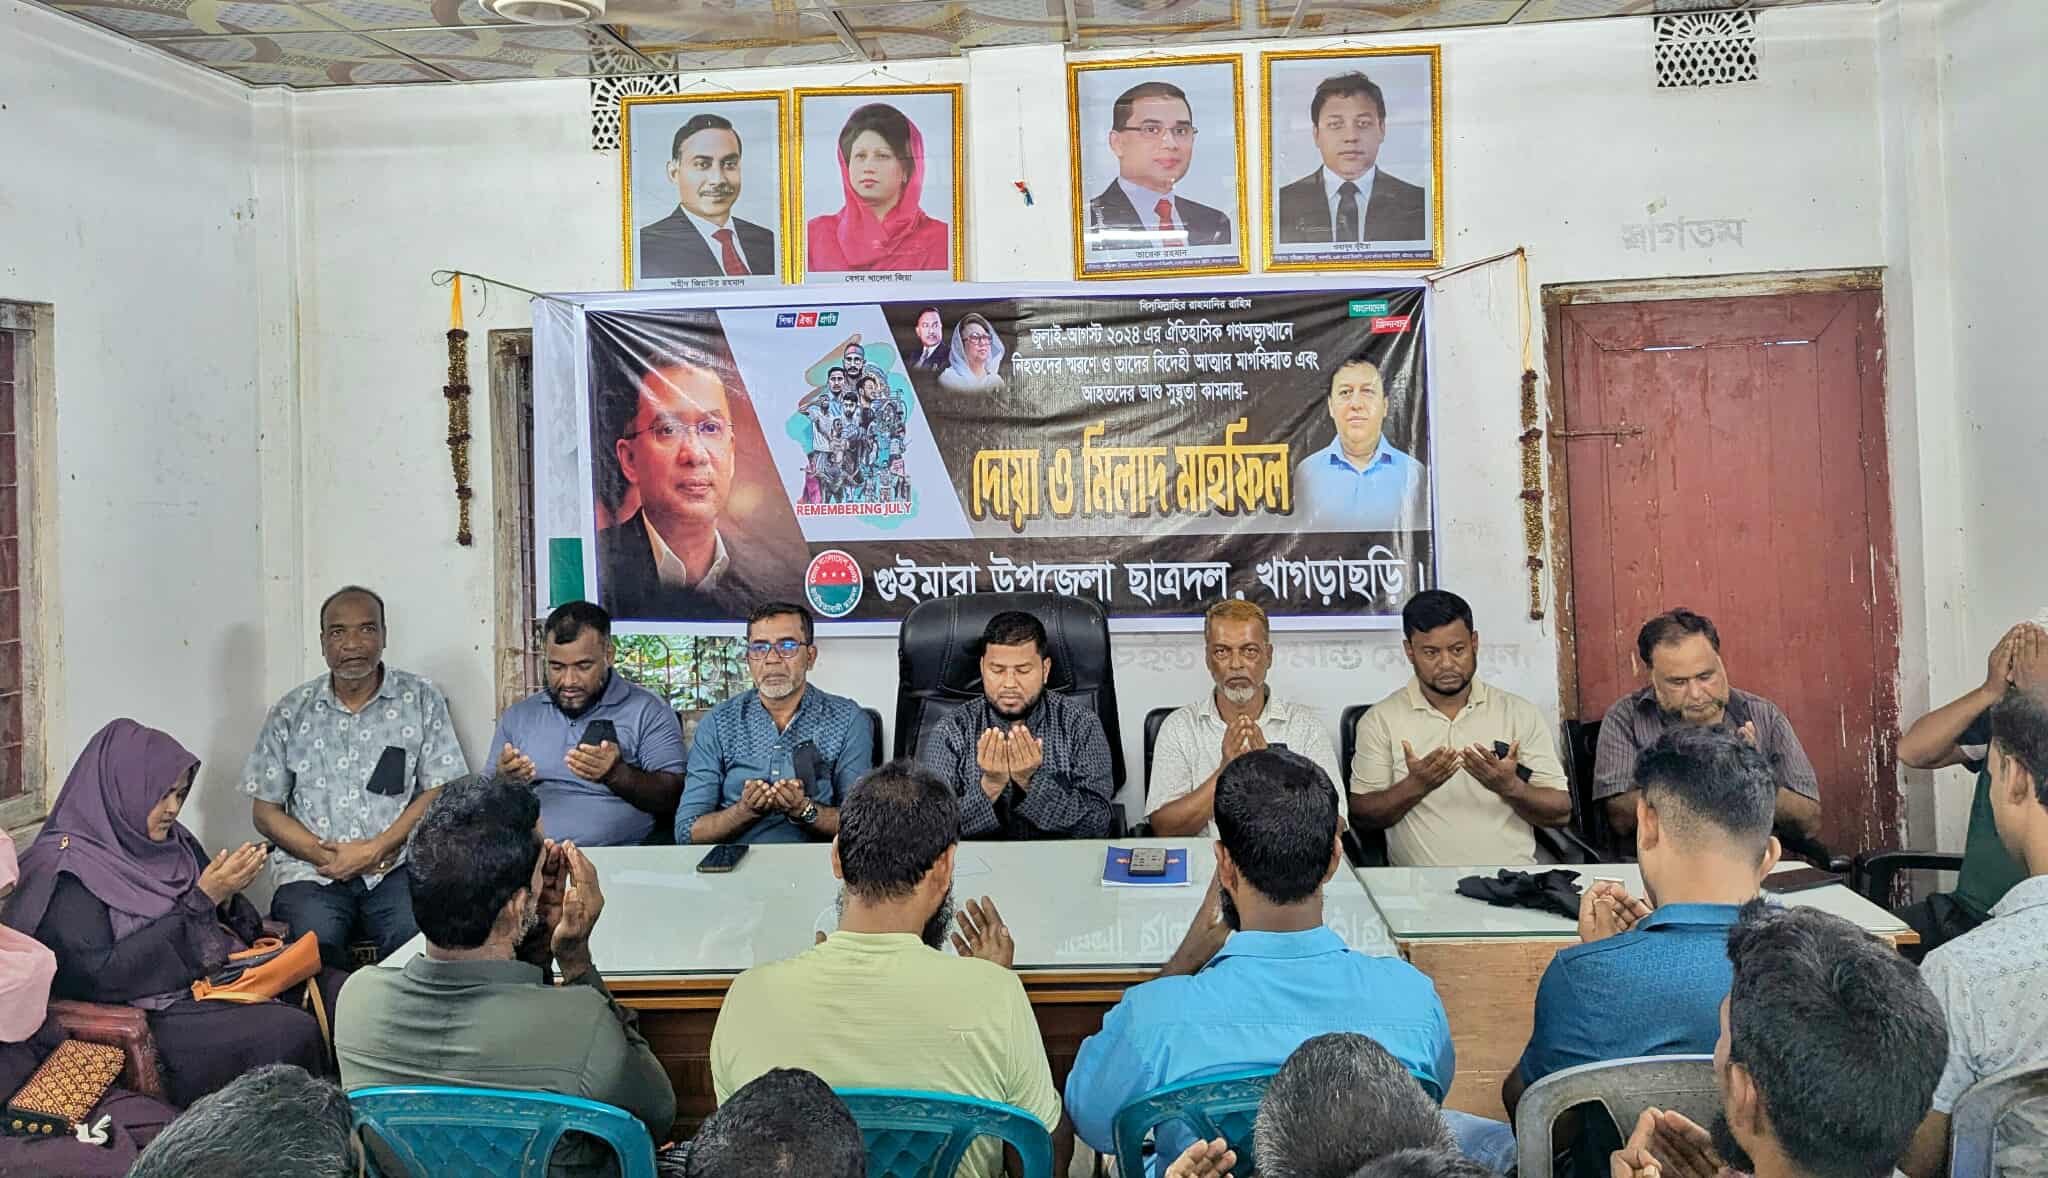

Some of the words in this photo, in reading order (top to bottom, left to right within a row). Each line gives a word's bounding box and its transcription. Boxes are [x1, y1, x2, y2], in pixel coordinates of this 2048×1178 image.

[1107, 325, 1140, 346] ২০২৪
[1143, 324, 1162, 344] এর
[1165, 317, 1223, 345] ঐতিহাসিক
[1011, 351, 1063, 376] নিহতদের
[1102, 356, 1112, 373] ও
[1114, 355, 1150, 375] তাদের
[1153, 348, 1191, 374] বিদেহী
[1235, 346, 1293, 372] মাগফিরাত
[1295, 350, 1320, 371] এবং
[1081, 384, 1135, 404] আহতদের
[1138, 382, 1163, 403] আশু
[973, 448, 1041, 530] দোয়া
[1048, 448, 1074, 515] ও
[1081, 419, 1169, 514] মিলাদ
[1174, 416, 1290, 513] মাহফিল
[796, 503, 882, 516] REMEMBERING
[884, 502, 912, 516] JULY
[873, 553, 981, 604] গুইমারা
[986, 551, 1117, 603] উপজেলা
[1256, 544, 1407, 606] খাগড়াছড়ি
